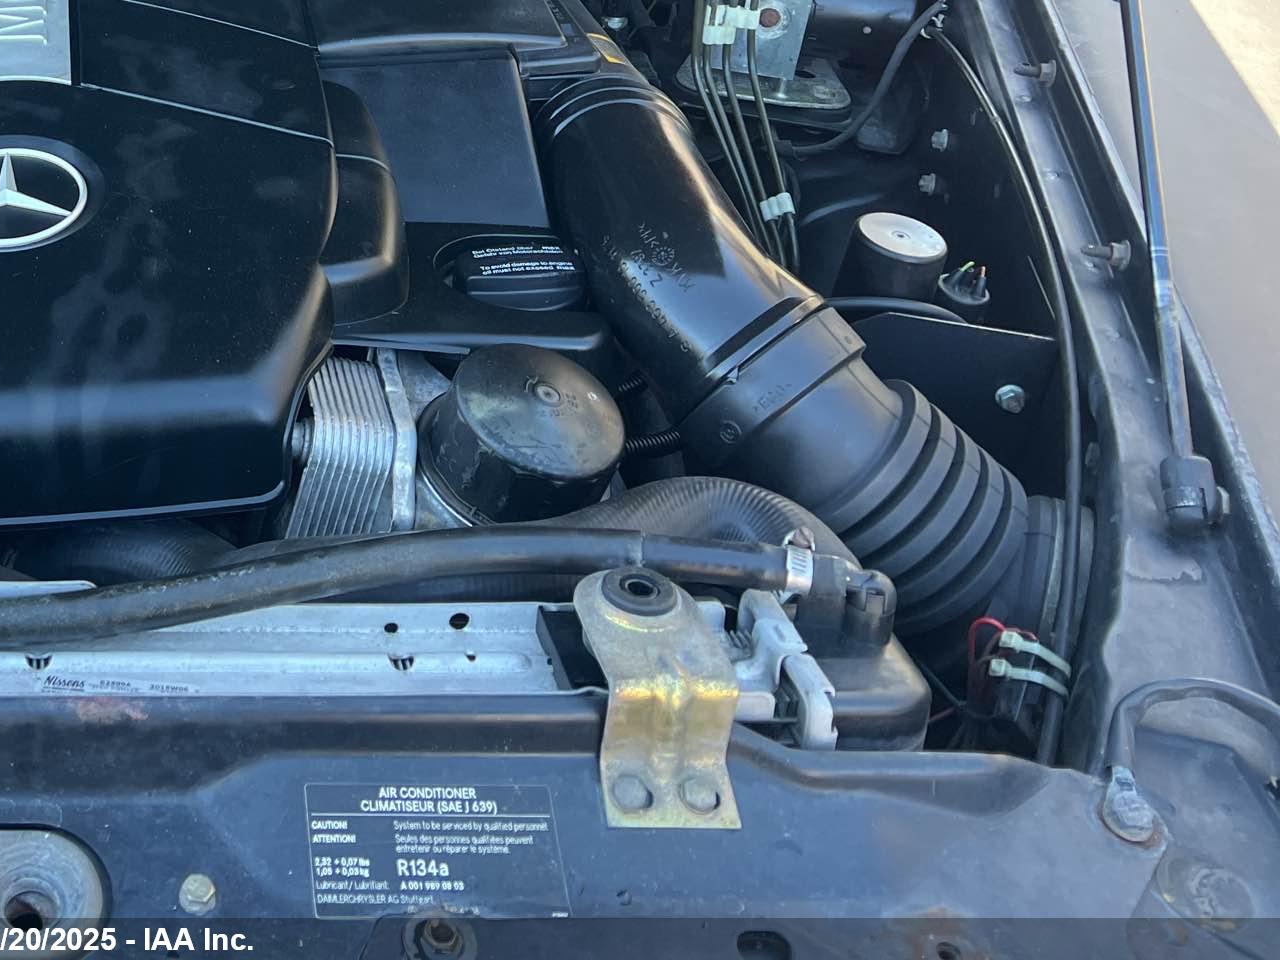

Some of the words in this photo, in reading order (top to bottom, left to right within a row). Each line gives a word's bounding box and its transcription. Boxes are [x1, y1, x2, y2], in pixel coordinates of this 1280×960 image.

[44, 675, 86, 688] Nissens
[379, 787, 398, 799] AIR
[399, 787, 476, 799] CONDITIONER
[361, 800, 435, 812] CLIMATISEUR
[437, 800, 463, 814] (SAE
[464, 801, 470, 814] J
[472, 800, 498, 815] 639)
[393, 820, 421, 831] System
[422, 820, 431, 830] to
[442, 822, 472, 831] serviced
[472, 821, 482, 832] by
[396, 858, 450, 877] R134a
[401, 881, 408, 890] A
[317, 894, 386, 905] DAIMLERCHRYSLER
[387, 894, 400, 904] AG
